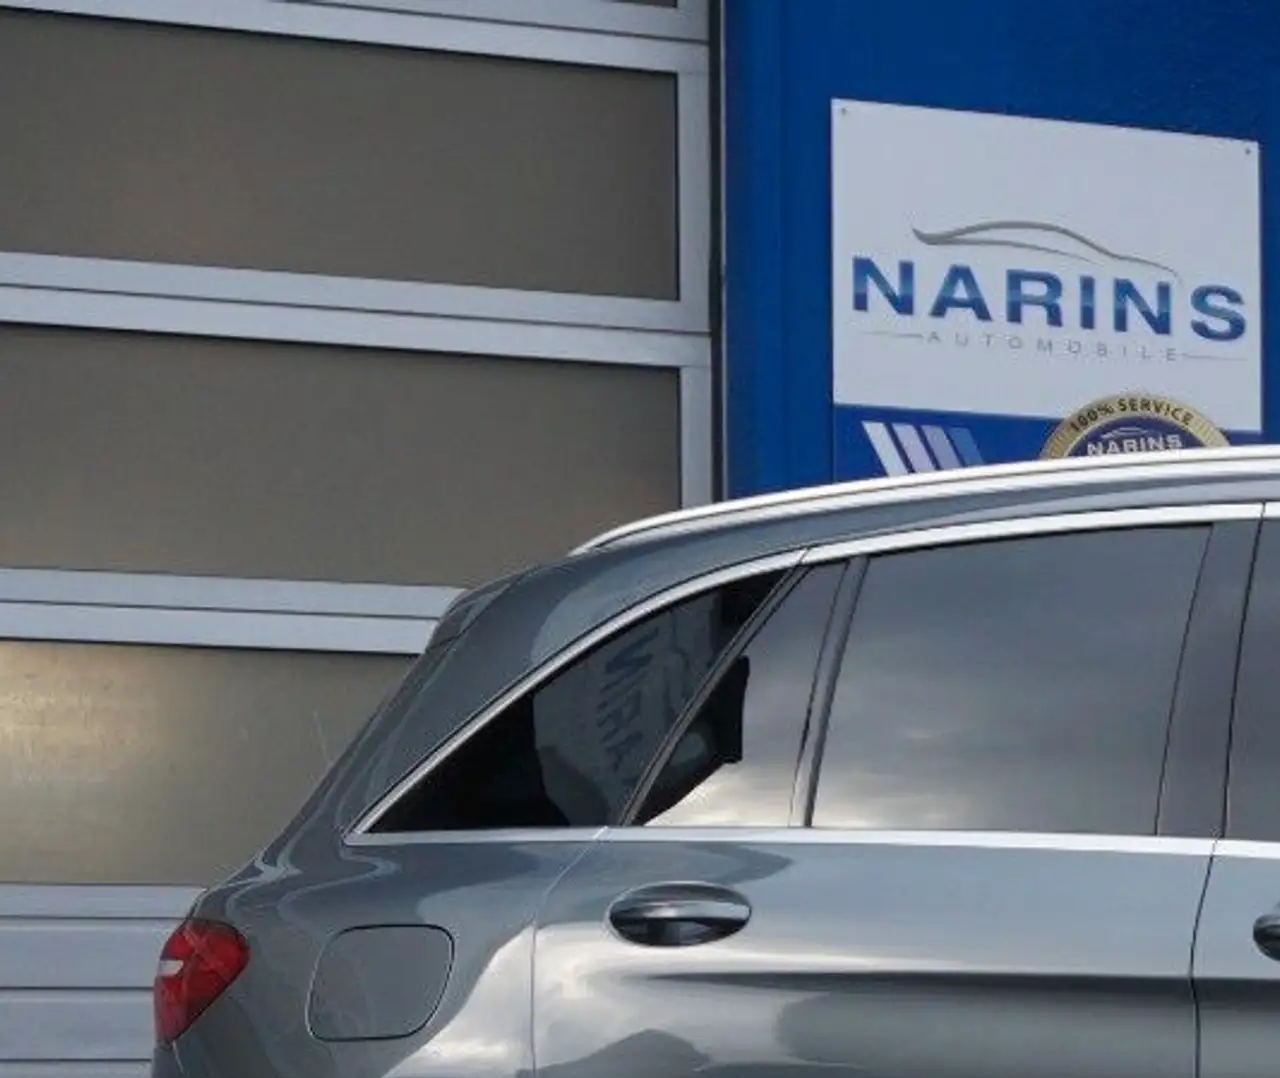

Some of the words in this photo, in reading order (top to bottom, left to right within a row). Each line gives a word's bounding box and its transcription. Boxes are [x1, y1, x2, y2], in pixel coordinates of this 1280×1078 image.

[852, 256, 1246, 341] NARINS
[927, 331, 1176, 362] AUTOMOBILE
[1070, 403, 1115, 431] 100%
[1118, 398, 1195, 426] SERVICE
[1087, 434, 1183, 456] NARINS
